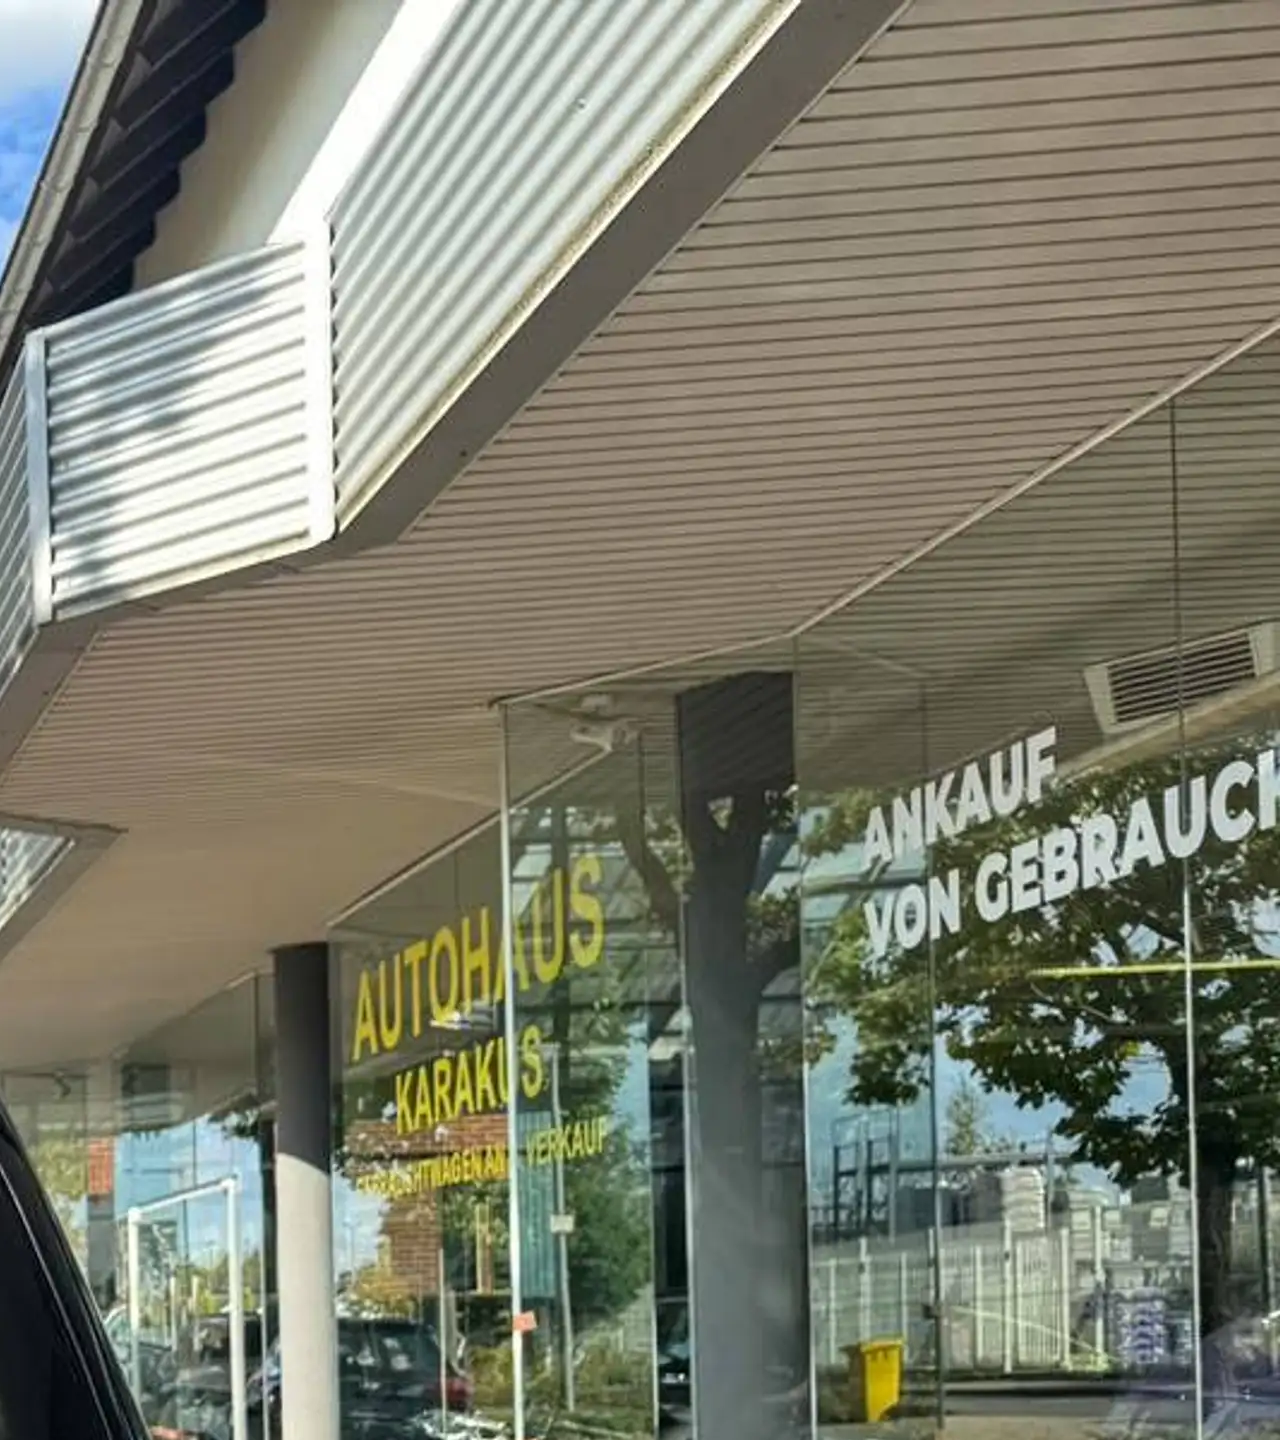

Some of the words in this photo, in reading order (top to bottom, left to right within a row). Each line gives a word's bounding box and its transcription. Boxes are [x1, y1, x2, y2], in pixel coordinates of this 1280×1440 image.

[861, 726, 1057, 873] ANKAUF
[351, 853, 605, 1062] AUTOHAUS
[863, 869, 961, 958] VON
[395, 1025, 544, 1135] KARAKUS
[525, 1115, 608, 1168] VERKAUF
